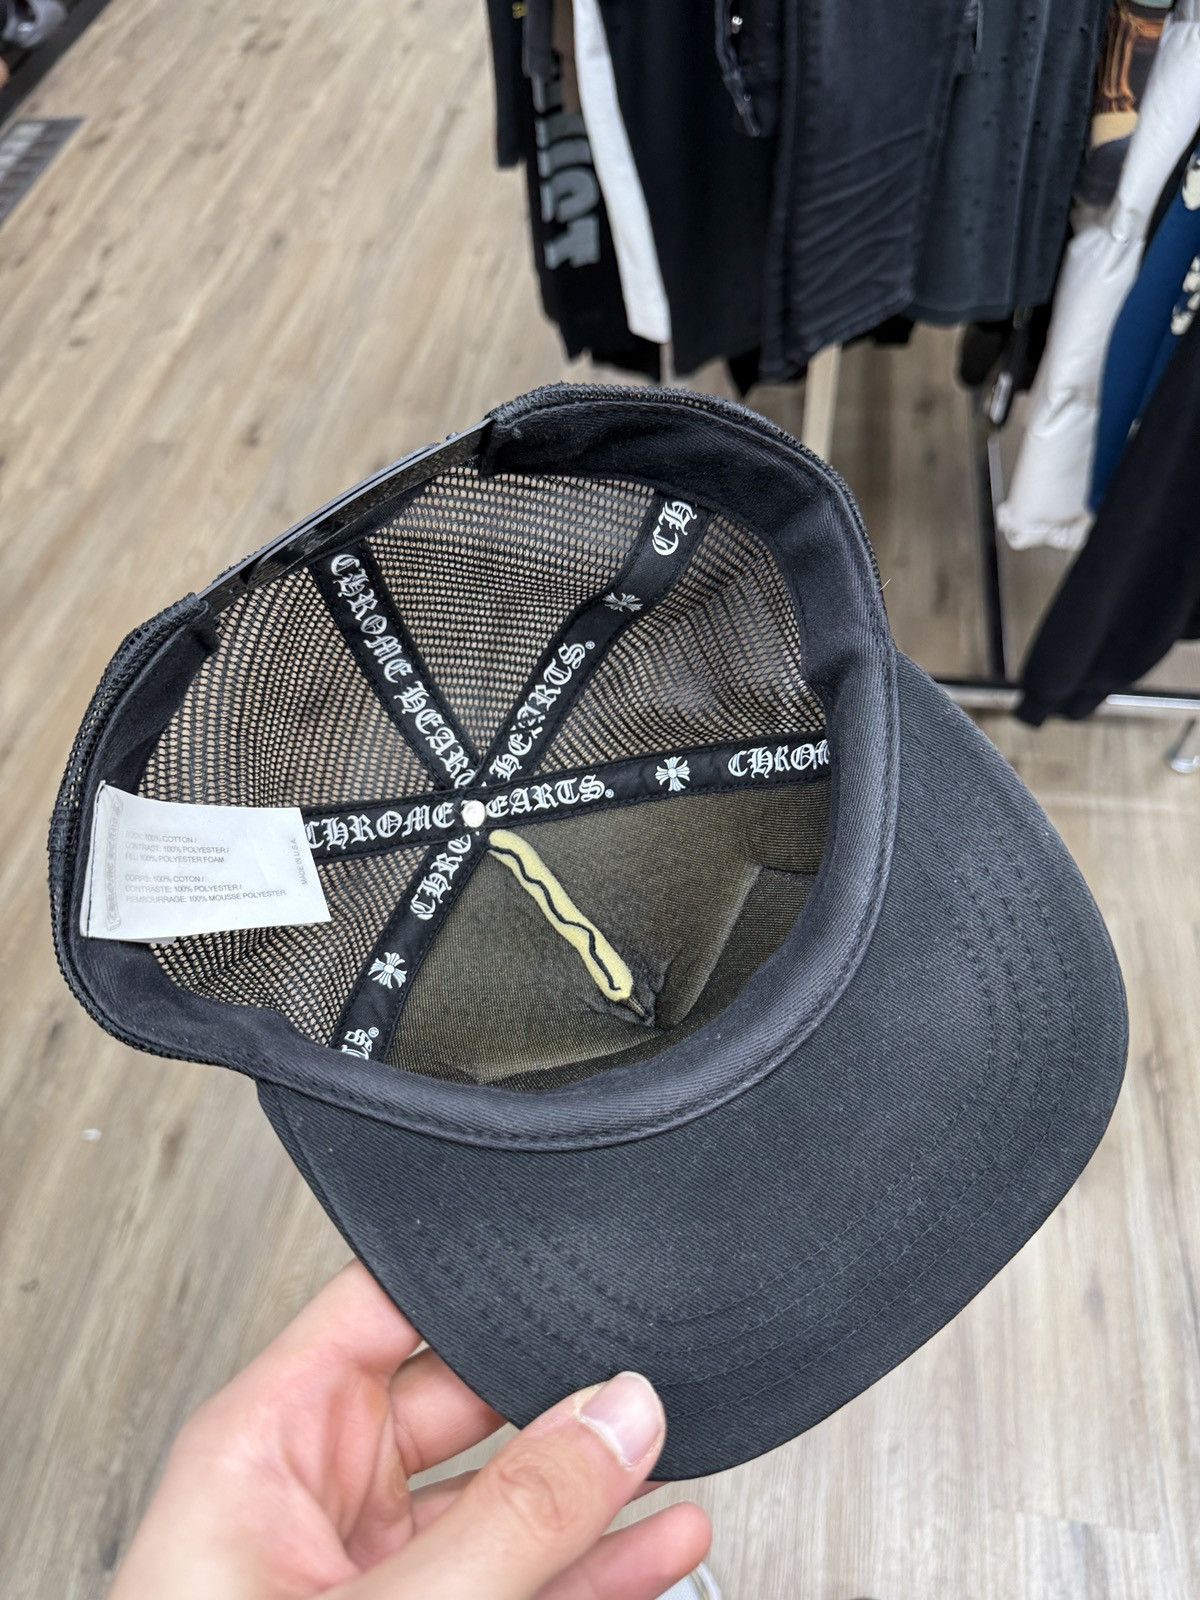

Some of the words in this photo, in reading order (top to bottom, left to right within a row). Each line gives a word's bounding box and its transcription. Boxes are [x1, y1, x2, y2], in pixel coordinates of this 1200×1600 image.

[330, 554, 413, 683] CHROME
[305, 802, 456, 851] CHROME
[162, 836, 193, 844] COTTON
[182, 846, 226, 854] POLYESTER
[158, 855, 202, 863] POLYESTER
[174, 885, 193, 893] 100%
[194, 884, 239, 893] POLYESTER
[189, 894, 207, 902] 100%
[208, 893, 241, 901] MOUSSE
[242, 889, 287, 899] POLYESTER
